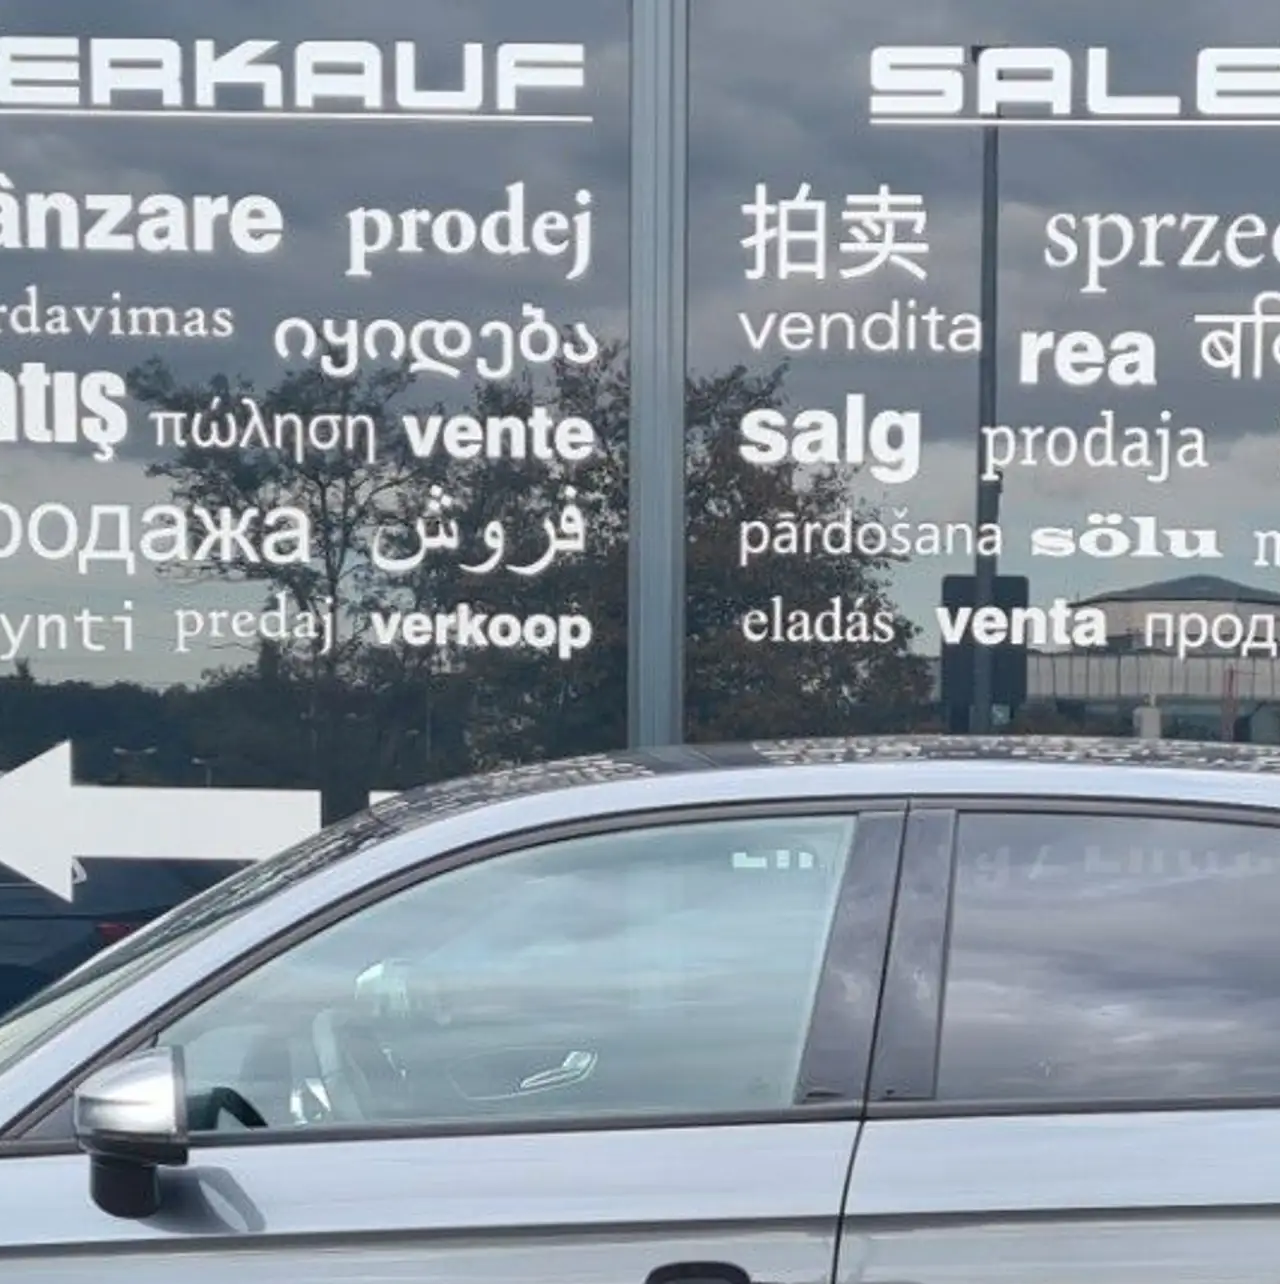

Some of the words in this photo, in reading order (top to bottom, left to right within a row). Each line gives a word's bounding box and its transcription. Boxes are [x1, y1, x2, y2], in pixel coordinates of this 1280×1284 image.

[345, 181, 592, 281] prodej
[740, 182, 930, 281] 拍卖
[274, 303, 599, 380] იყიდება
[738, 298, 982, 353] vendita
[1019, 330, 1157, 386] rea
[149, 396, 375, 464] πώληση
[401, 406, 595, 461] vente
[739, 393, 921, 485] salg
[981, 409, 1210, 484] prodaja
[740, 506, 1003, 566] pārdošana
[1030, 512, 1224, 559] sölu
[174, 589, 333, 654] predaj
[370, 603, 592, 659] verkoop
[742, 596, 895, 643] eladás
[934, 600, 1107, 647] venta
